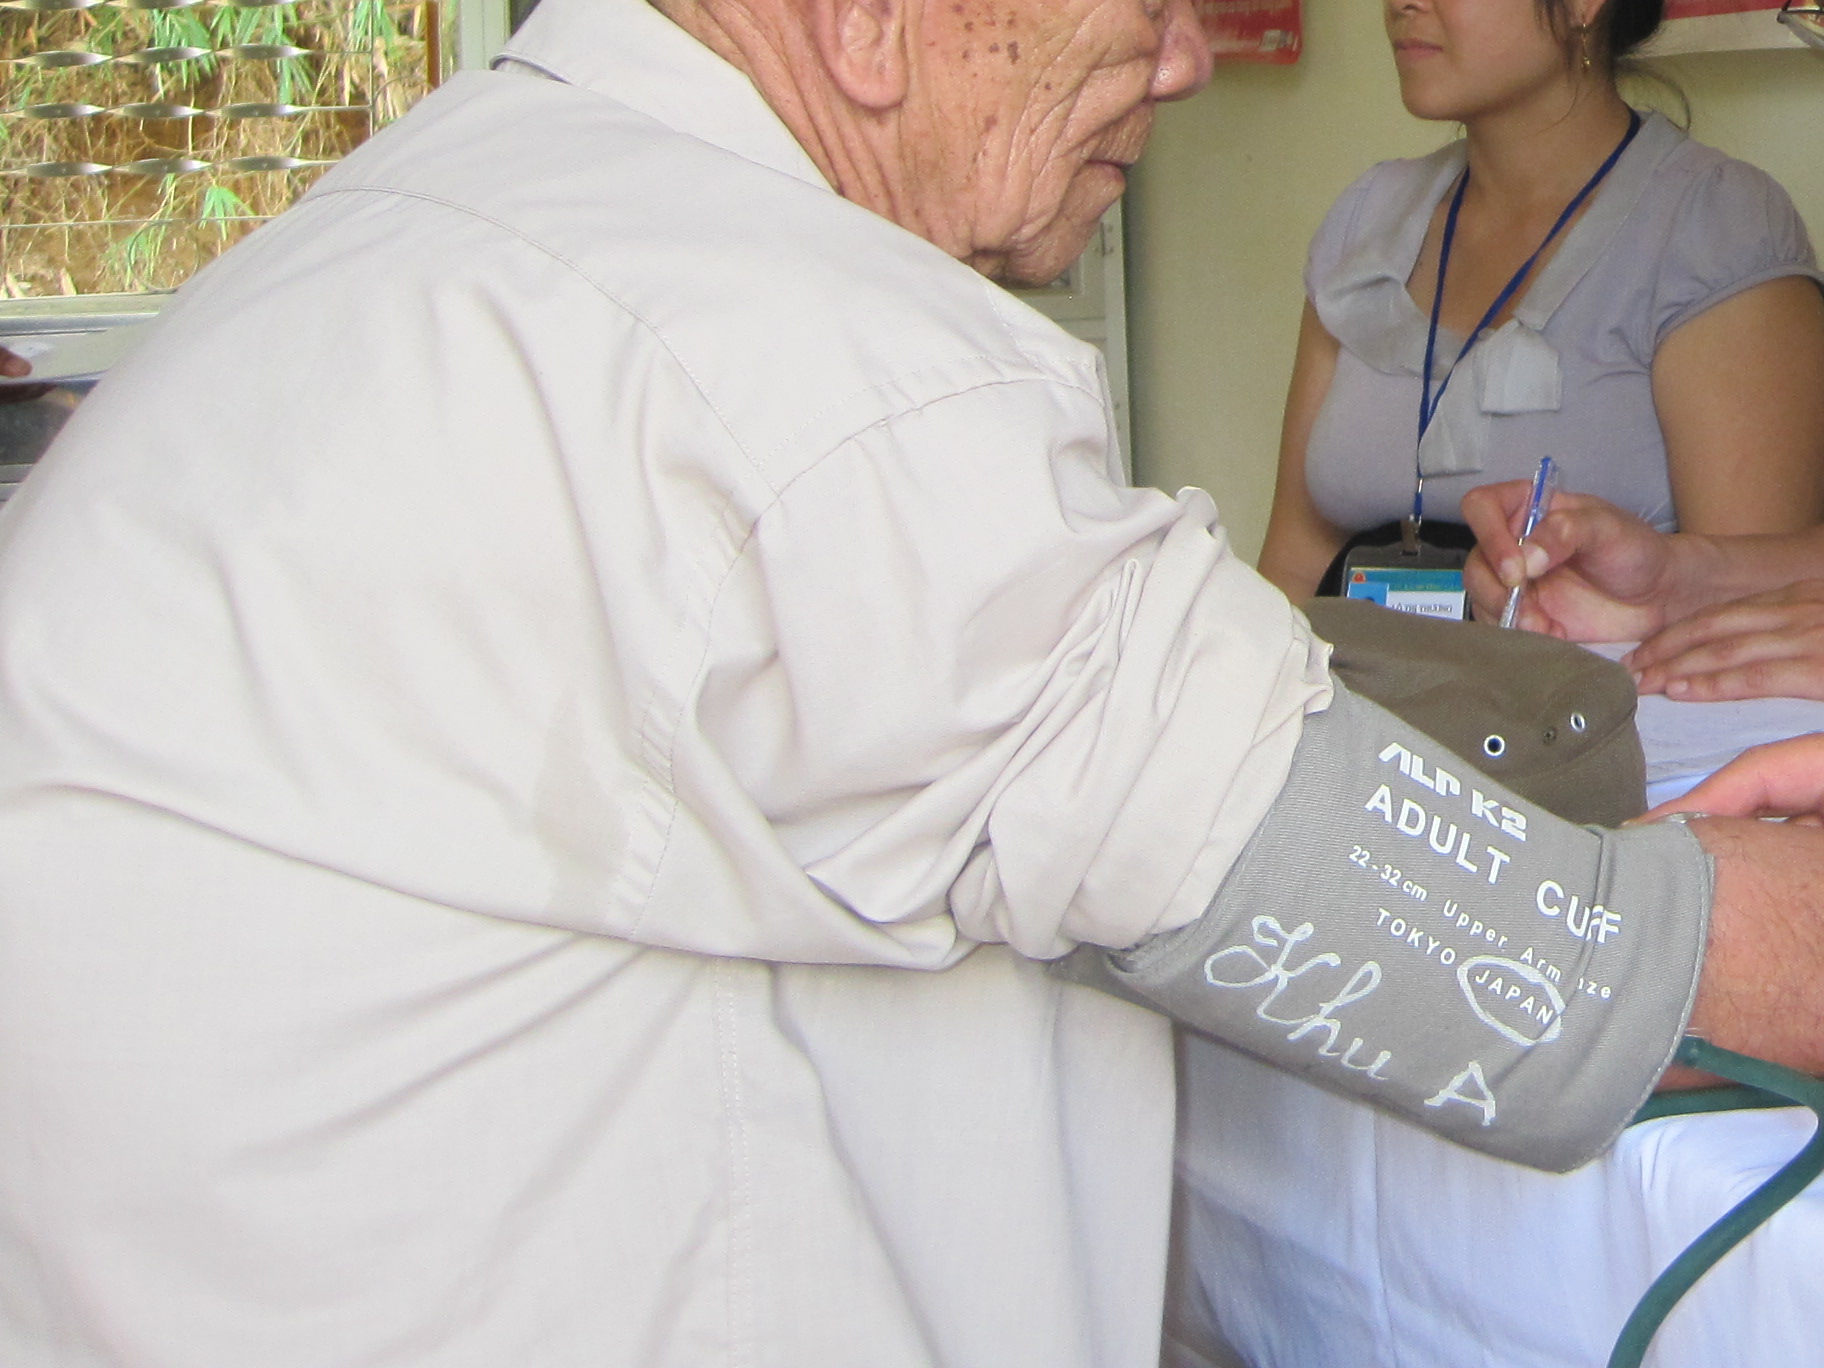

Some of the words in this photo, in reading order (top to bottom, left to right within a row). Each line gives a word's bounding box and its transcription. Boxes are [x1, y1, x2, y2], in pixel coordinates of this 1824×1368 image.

[1364, 783, 1511, 883] ADULT
[1375, 907, 1456, 965] TOKYO
[1475, 969, 1555, 1025] JAPAN
[1443, 898, 1508, 948] Upper
[1520, 947, 1562, 982] Arm
